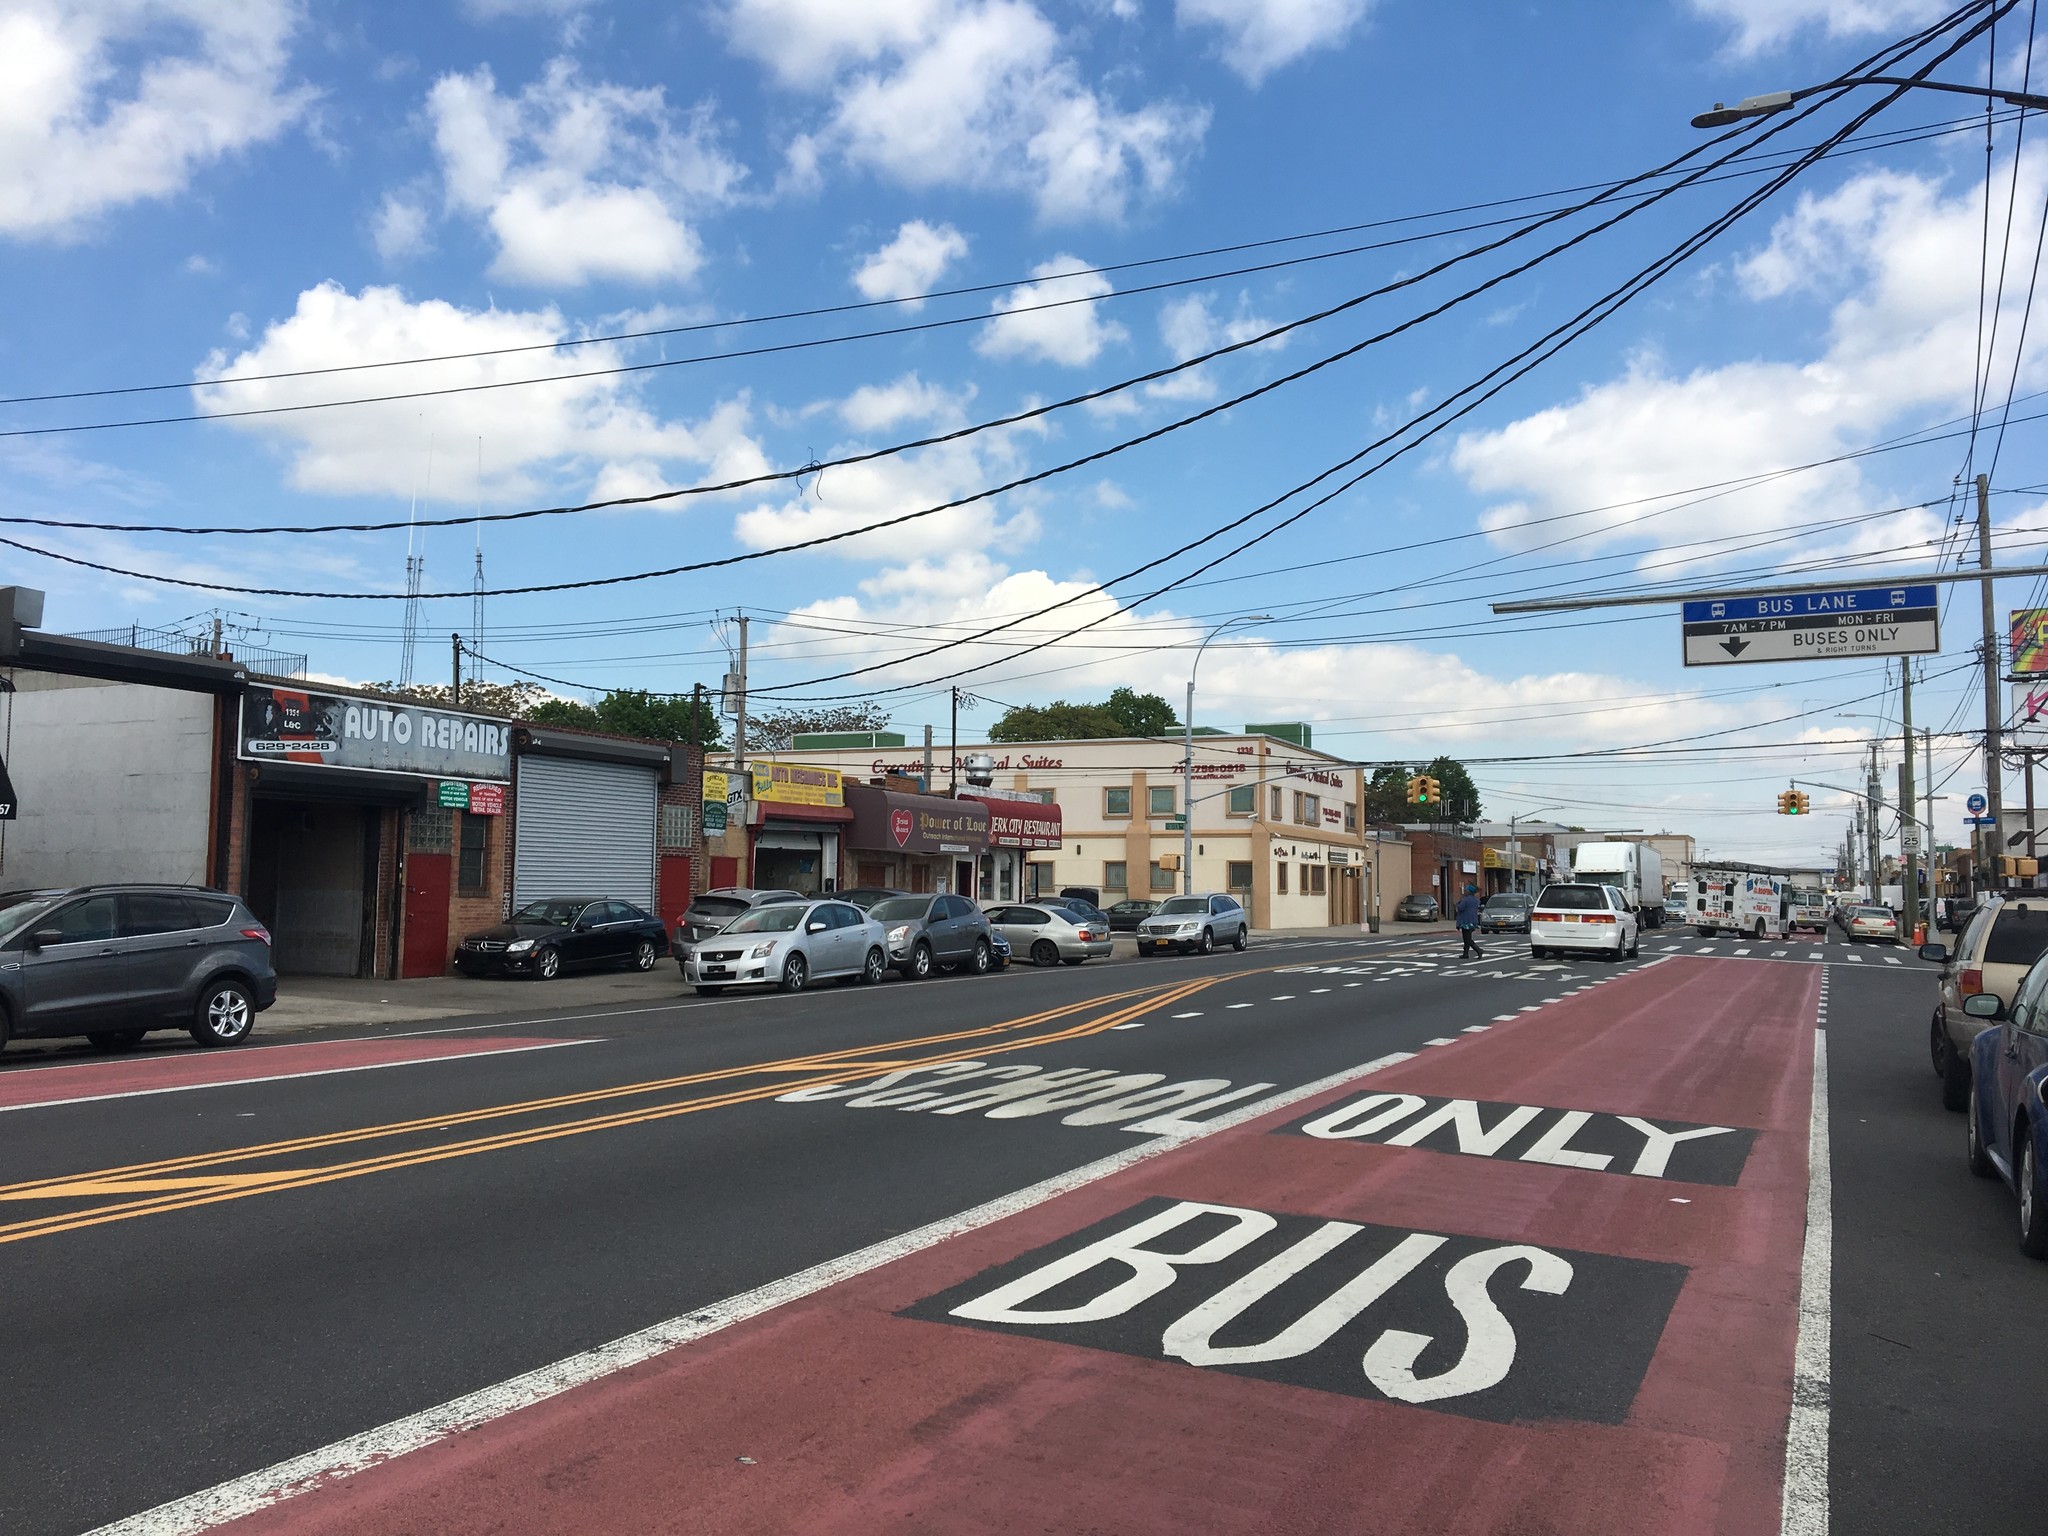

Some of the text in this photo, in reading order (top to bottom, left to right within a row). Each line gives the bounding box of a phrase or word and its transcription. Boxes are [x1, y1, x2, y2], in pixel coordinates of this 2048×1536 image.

[1758, 594, 1857, 614] BUS LANE
[1838, 615, 1863, 625] MON
[1876, 612, 1894, 623] FRI
[1793, 627, 1899, 646] BUSES ONLY
[1851, 644, 1877, 652] TURNS
[283, 720, 301, 730] L&C
[344, 706, 509, 756] AUTO REPAIRS
[255, 742, 330, 752] 629-2428
[1016, 754, 1063, 770] Suites
[473, 783, 501, 794] REGISTERED
[726, 789, 742, 804] GTX
[920, 812, 987, 832] Power of Love
[990, 816, 1061, 836] JERK CITY RESTAURANT
[1904, 837, 1919, 846] 25
[1438, 969, 1590, 982] ONLY
[1301, 1093, 1736, 1178] ONLY
[949, 1200, 1574, 1403] BUS
